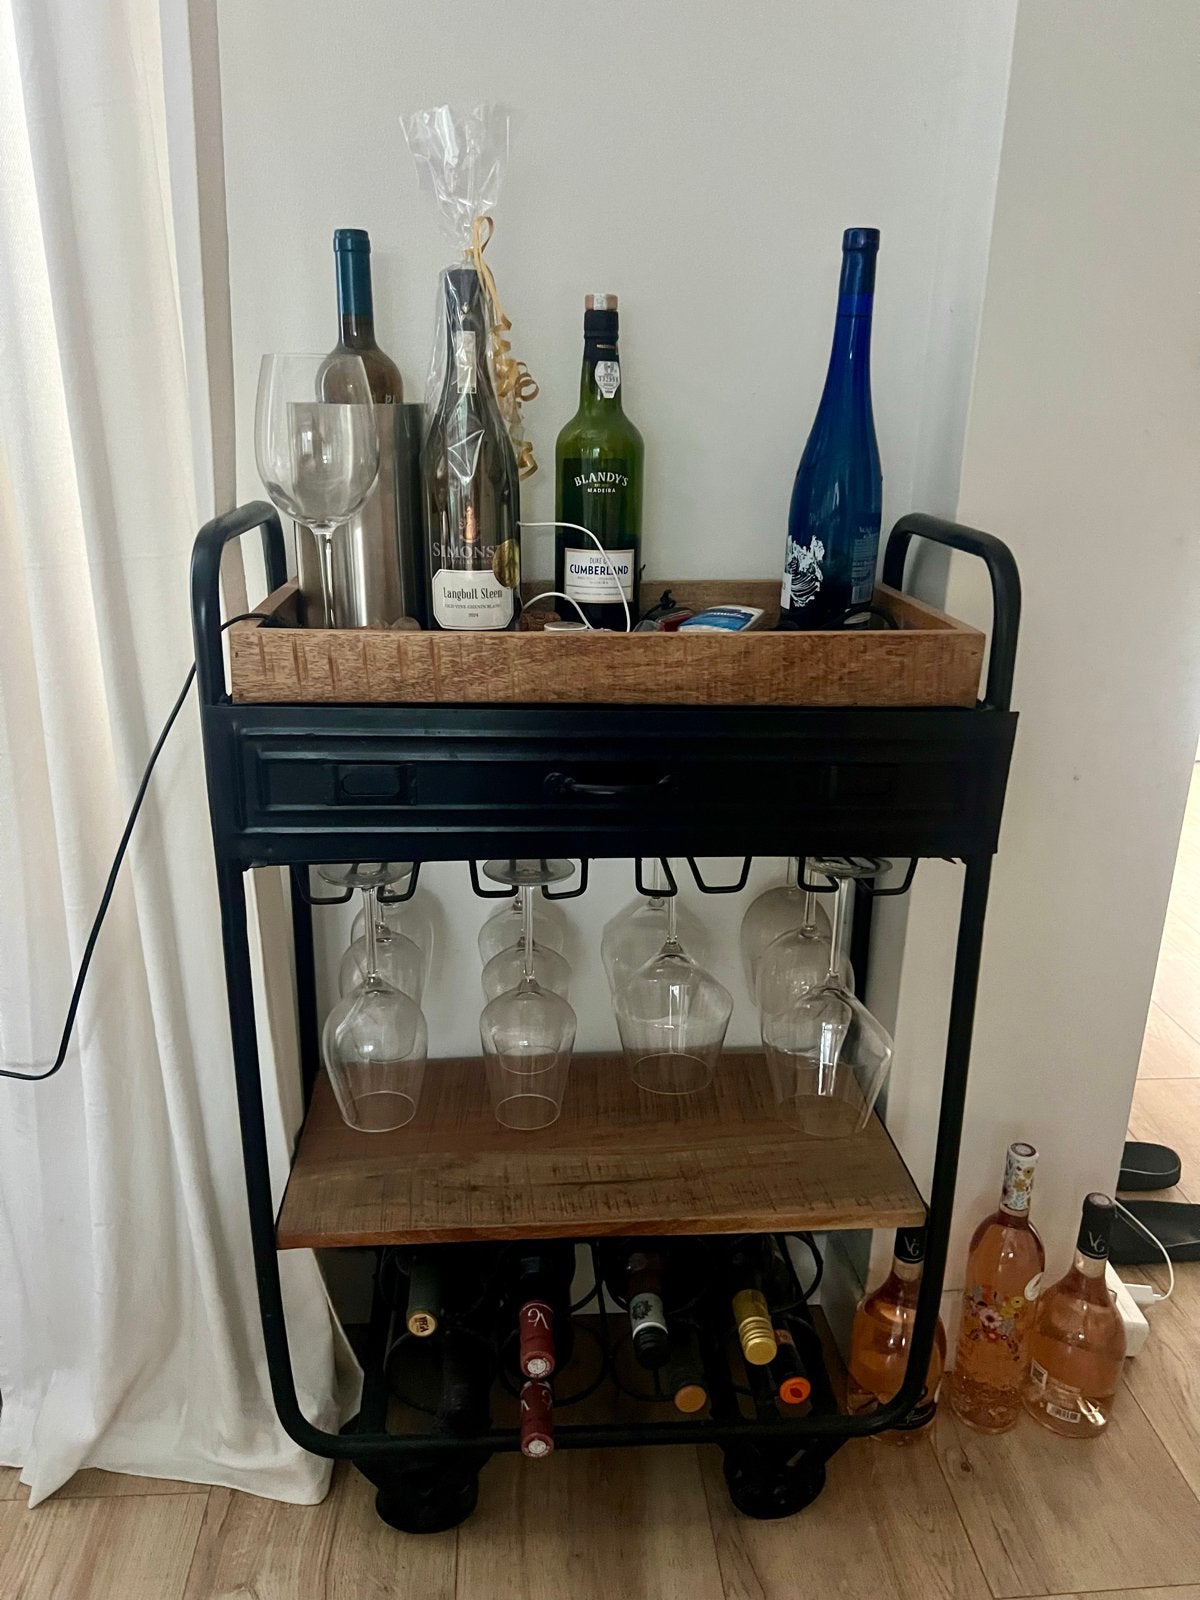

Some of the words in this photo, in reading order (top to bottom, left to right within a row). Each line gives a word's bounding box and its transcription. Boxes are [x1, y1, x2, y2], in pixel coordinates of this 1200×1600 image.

[574, 471, 629, 487] BLANDY'S
[570, 564, 629, 576] CUMBERLAND
[443, 587, 479, 601] Langbult
[481, 588, 503, 599] Steen
[1088, 1230, 1106, 1253] VG
